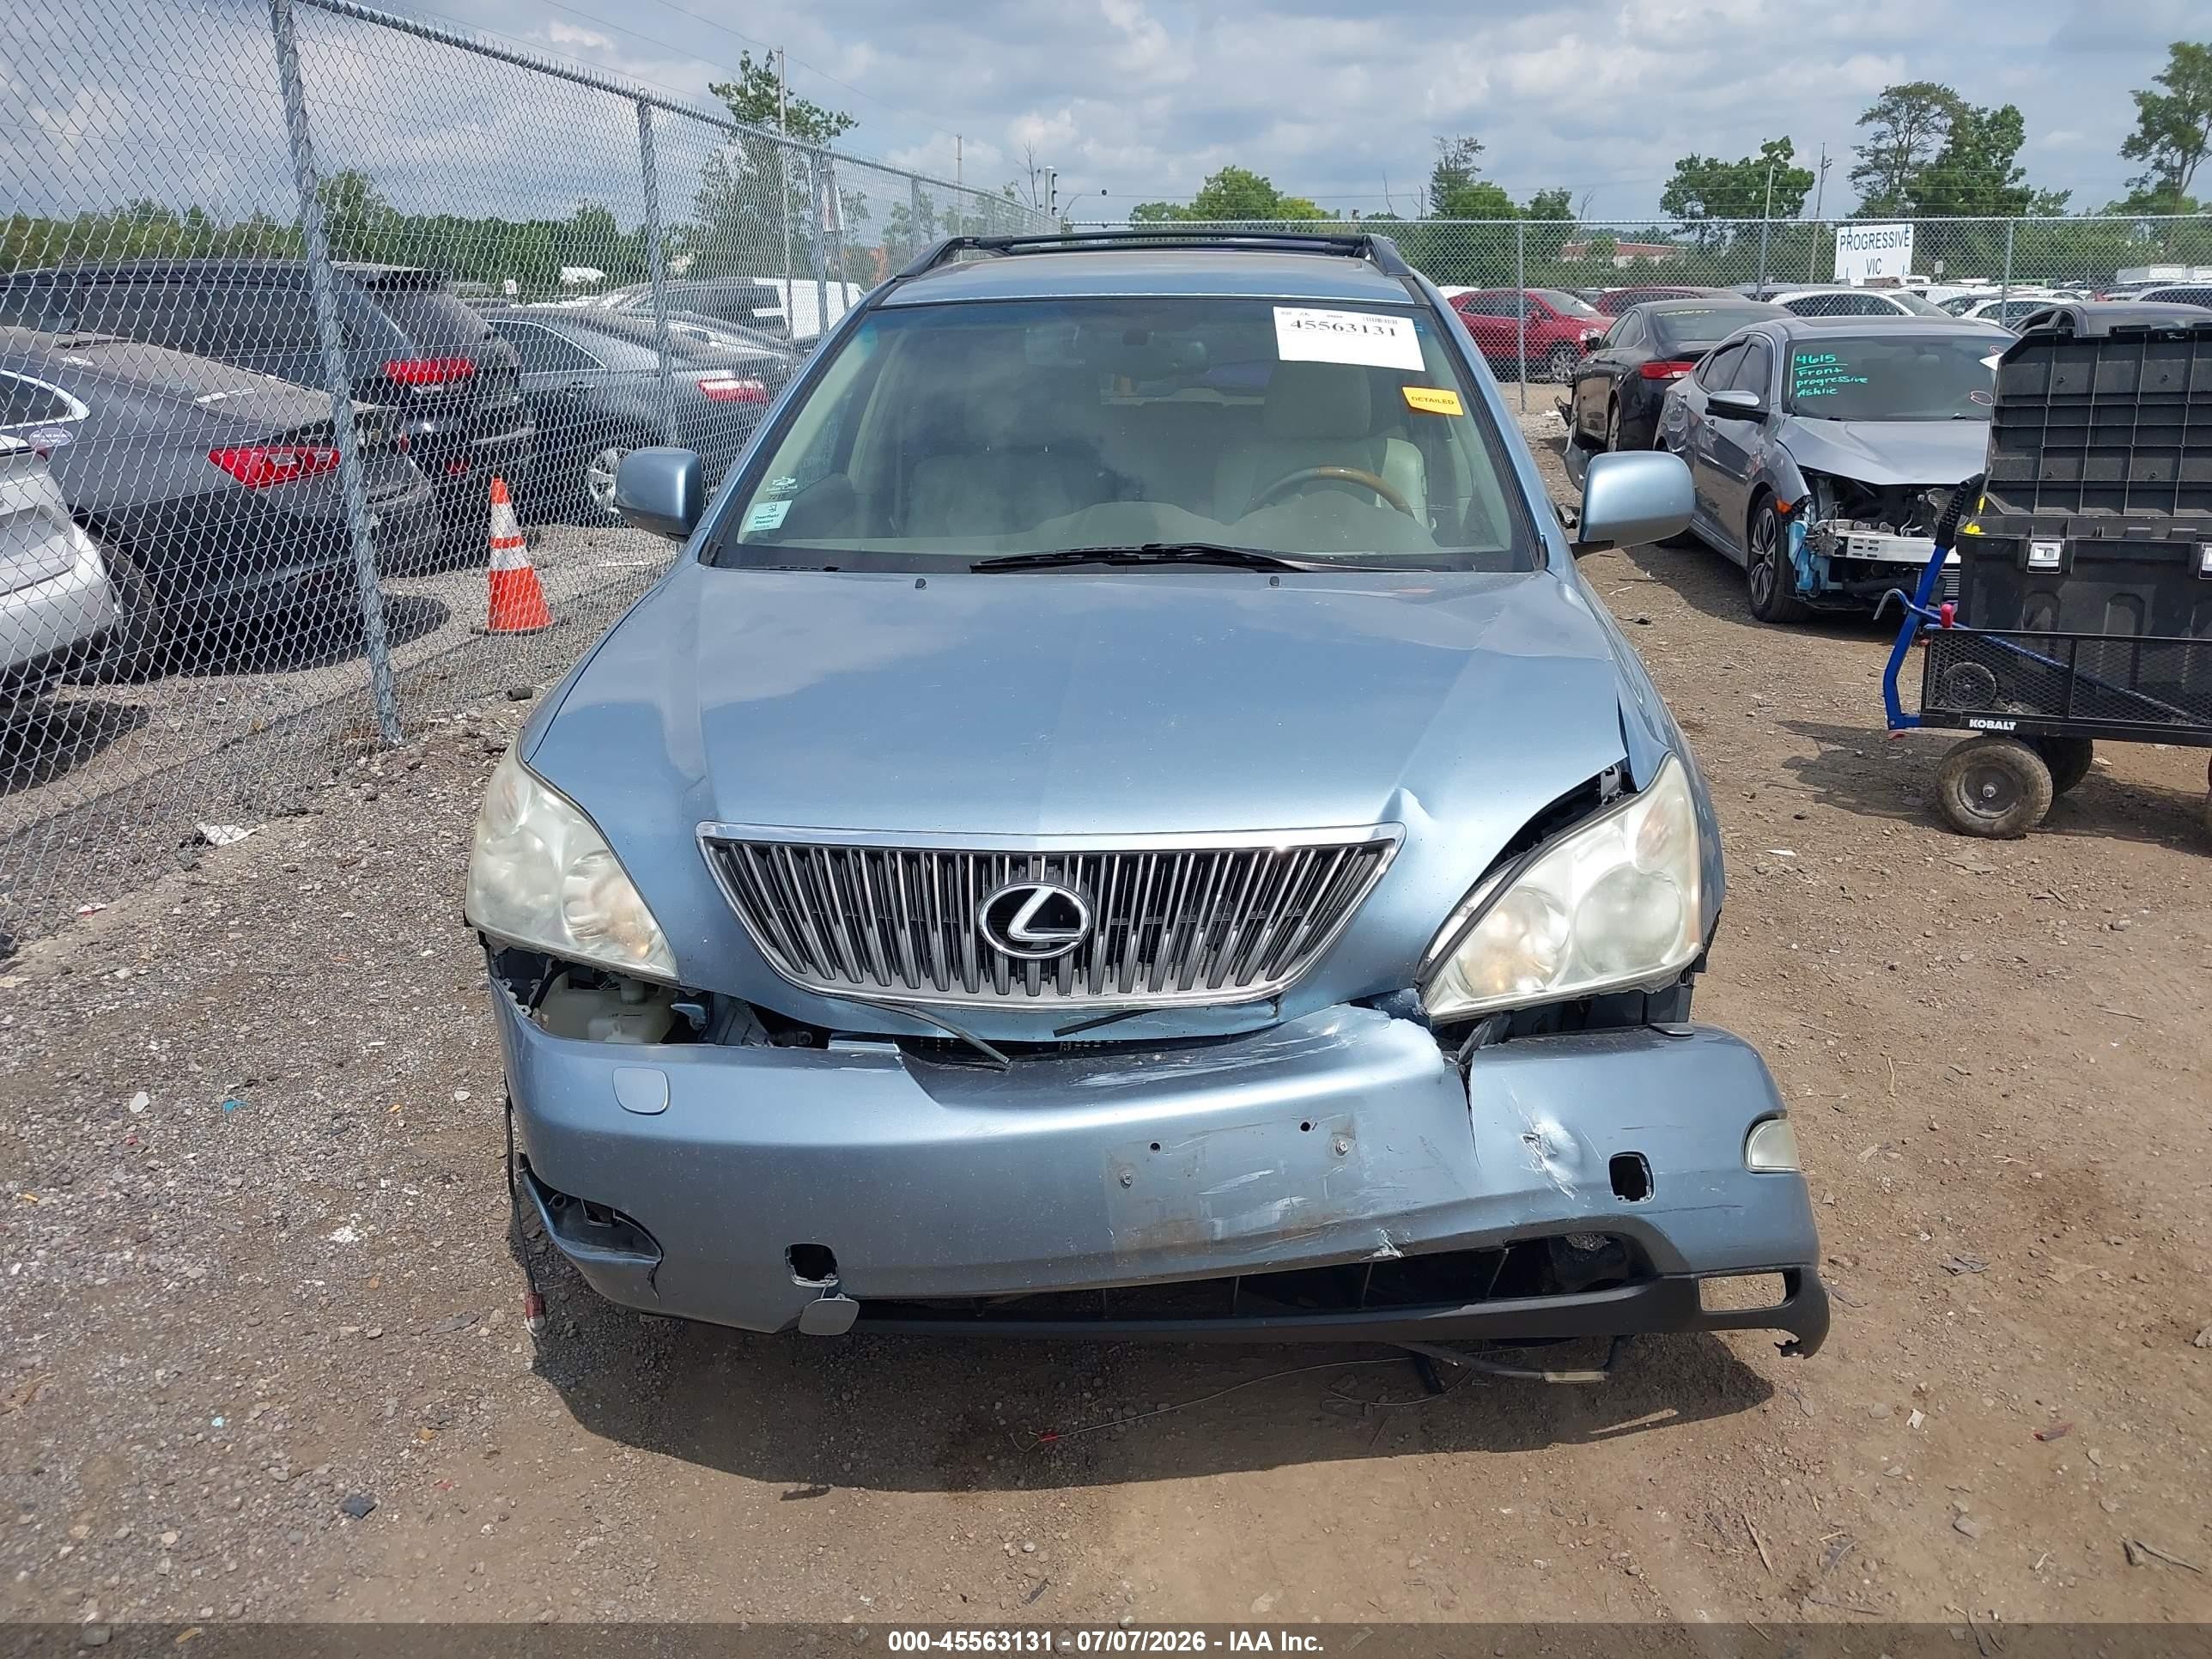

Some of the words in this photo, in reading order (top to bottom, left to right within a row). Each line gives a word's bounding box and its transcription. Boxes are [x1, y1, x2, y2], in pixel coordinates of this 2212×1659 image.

[1839, 230, 1910, 252] PROGRESSIVE
[1866, 258, 1882, 276] VIC
[1290, 319, 1396, 337] 45563131
[1796, 354, 1837, 364] 4615
[1798, 367, 1844, 376] Front
[1411, 396, 1455, 405] DETAILED
[1969, 718, 2016, 731] KOBALT
